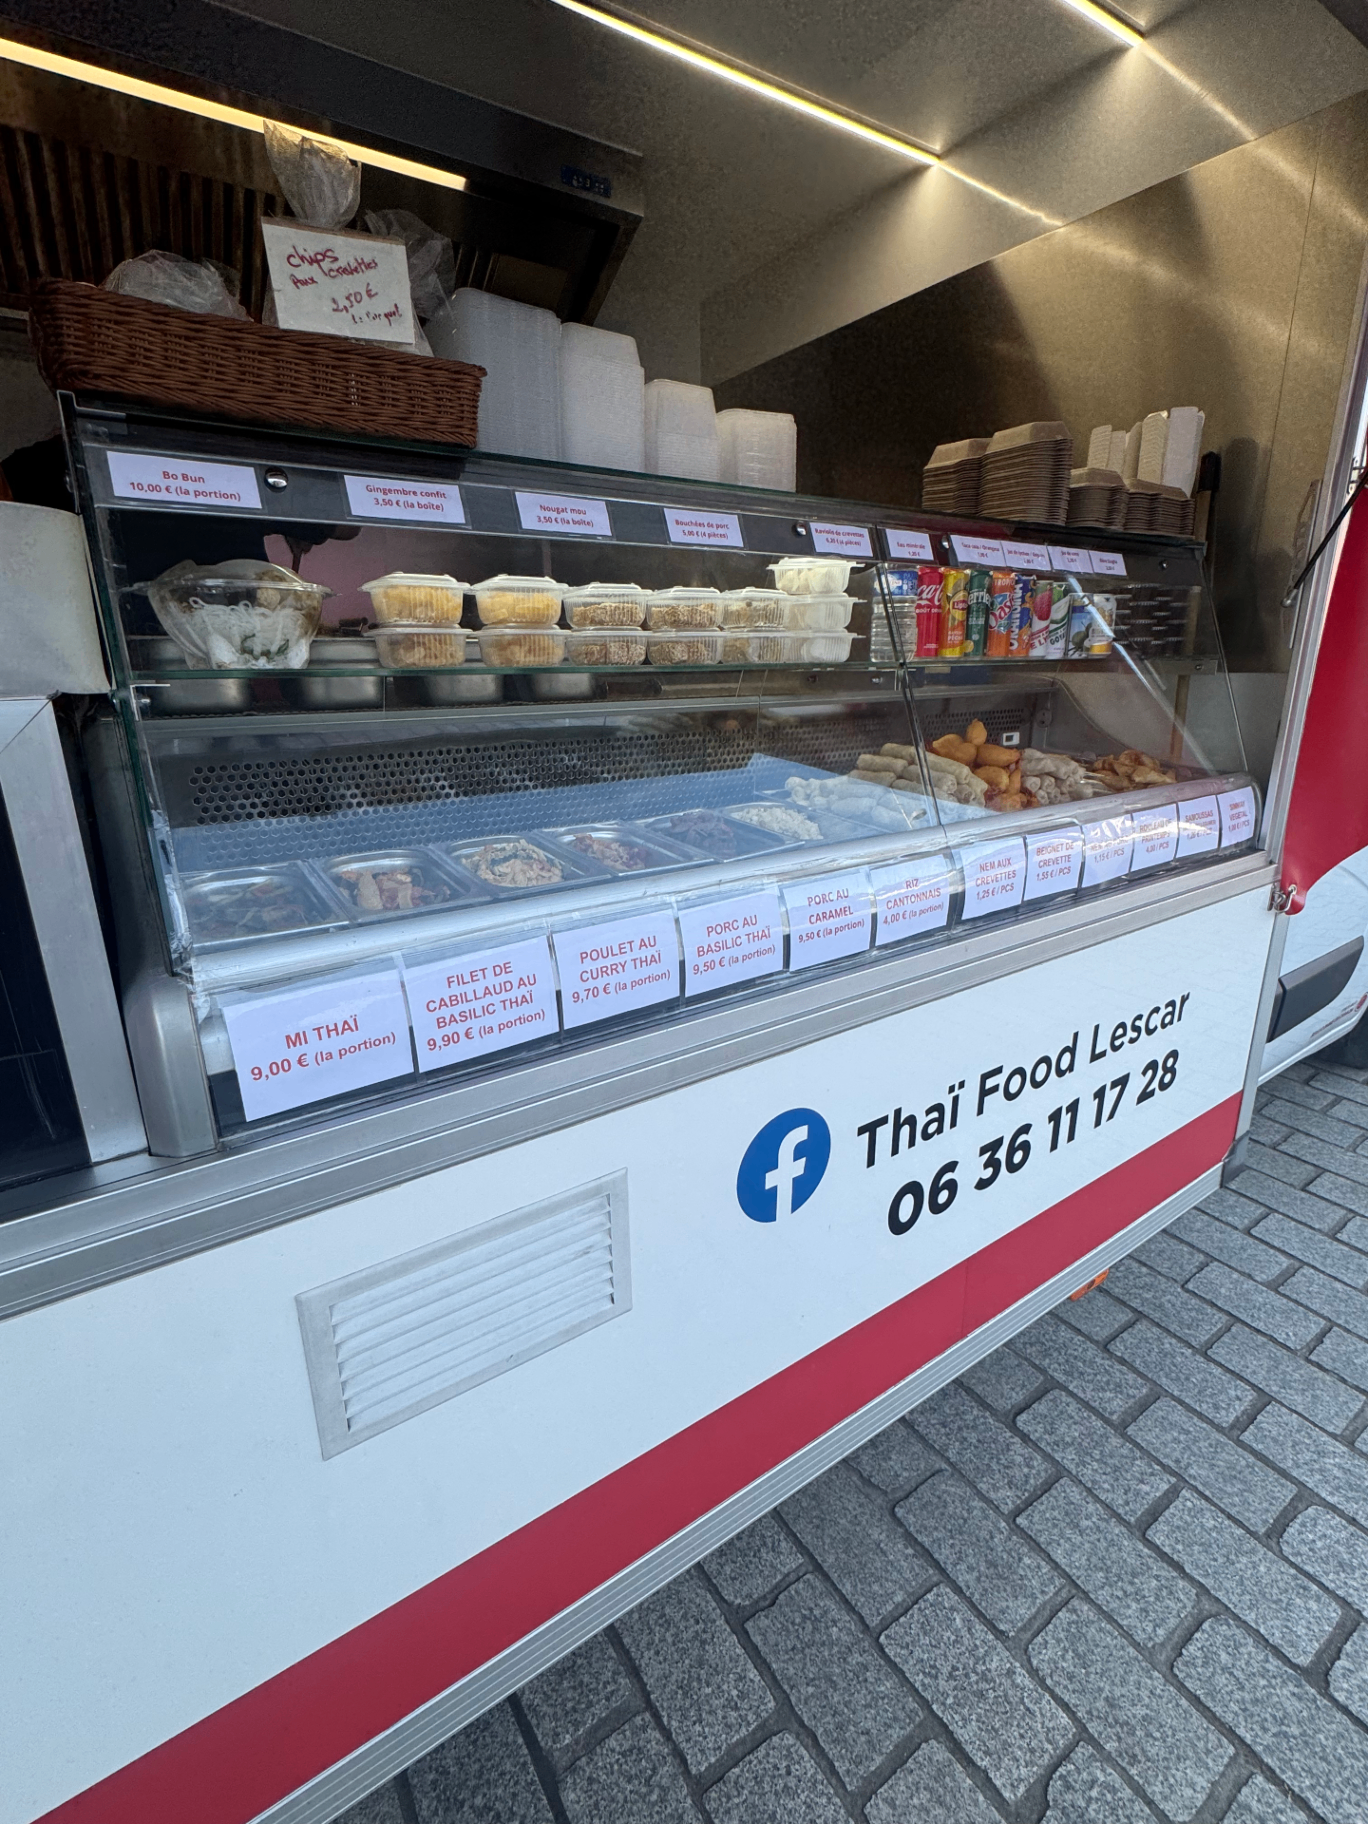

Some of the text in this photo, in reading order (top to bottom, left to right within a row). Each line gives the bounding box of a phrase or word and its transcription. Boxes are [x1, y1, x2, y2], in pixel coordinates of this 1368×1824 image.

[162, 470, 205, 483] Bo Bun
[130, 482, 241, 502] 10,00 € (la portion)
[365, 485, 447, 499] Gingembre confit
[373, 497, 393, 507] 3,50
[403, 500, 415, 509] (la
[417, 501, 444, 512] boîte)
[539, 504, 568, 515] Nougat
[537, 515, 553, 524] 3,50
[560, 517, 570, 525] (la
[675, 519, 705, 528] Bouchées
[1036, 843, 1064, 857] BEIGNET
[1038, 854, 1072, 869] CREVETTE
[979, 857, 1012, 873] NEM AUX
[1058, 866, 1072, 877] PCS
[905, 878, 919, 890] RIZ
[975, 869, 1017, 887] CREVETTES
[991, 887, 996, 897] €
[1000, 882, 1015, 894] PCS
[807, 888, 849, 907] PORC AU
[886, 887, 941, 910] CANTONNAIS
[808, 905, 854, 925] CARAMEL
[883, 901, 944, 926] 4,00 € (la portion)
[706, 914, 758, 938] PORC AU
[798, 918, 865, 944] 9,50 € (la portion)
[579, 935, 657, 964] POULET AU
[696, 925, 771, 958] BASILIC THAÏ
[579, 949, 662, 983] CURRY THAÏ
[692, 944, 776, 975] 9,50 € (la portion)
[446, 961, 513, 989] FILET DE
[571, 969, 671, 1004] 9,70 € (la portion)
[425, 973, 537, 1013] CABILLAUD AU
[436, 989, 534, 1030] BASILIC THAÏ
[285, 1014, 359, 1049] MI THAÏ
[427, 1008, 546, 1051] 9,90 € (la portion)
[250, 1031, 397, 1081] 9,00 € (la portion)
[857, 991, 1191, 1169] Thaï Food Lescar
[887, 1049, 1180, 1236] 06 36 11 17 28
